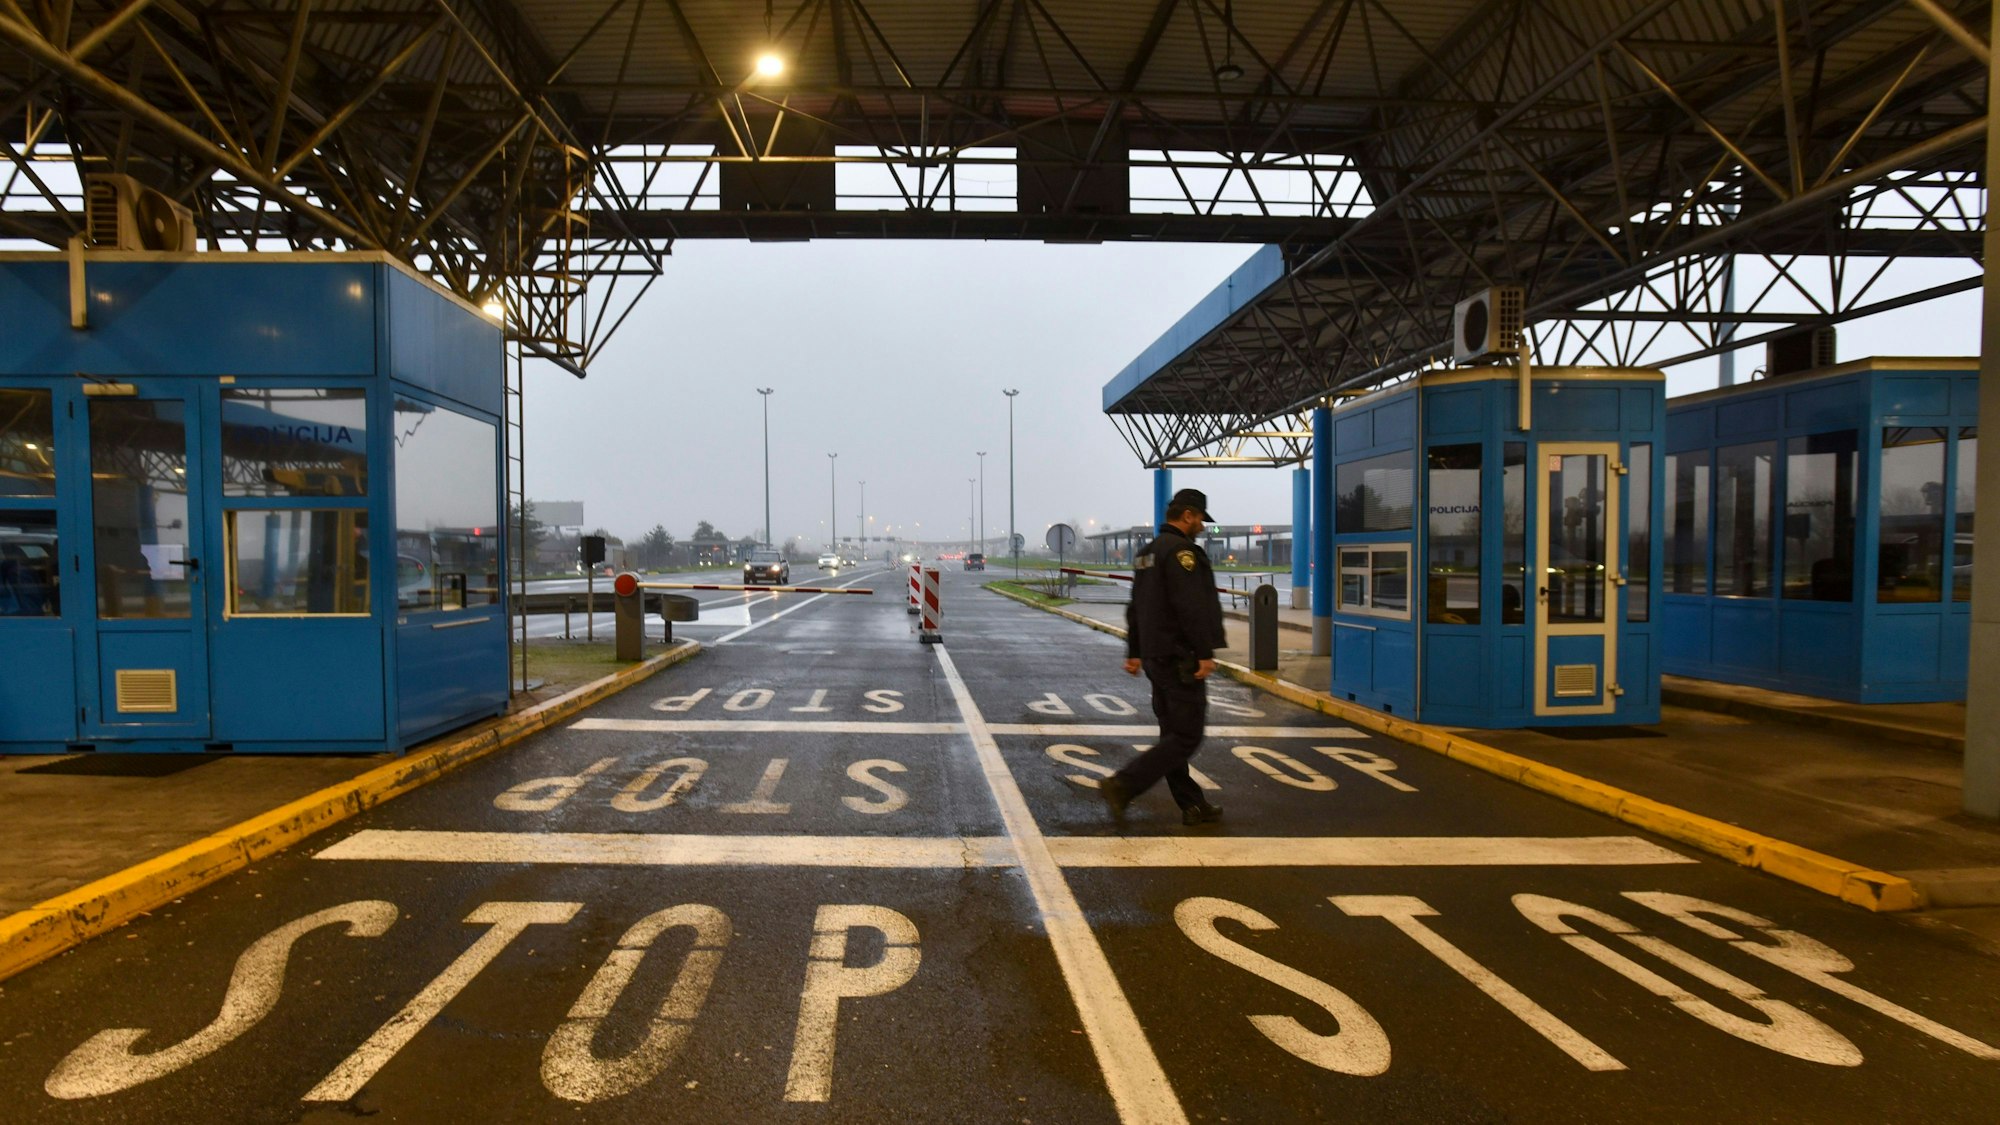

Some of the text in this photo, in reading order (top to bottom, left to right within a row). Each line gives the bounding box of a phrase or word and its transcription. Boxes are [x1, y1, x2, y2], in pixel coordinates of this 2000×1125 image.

[1430, 506, 1481, 514] POLICIJA
[651, 688, 905, 713] STOP
[1026, 693, 1267, 718] SOP
[493, 757, 912, 815] STOP
[44, 900, 922, 1103] STOP
[1174, 891, 2000, 1077] STOP
